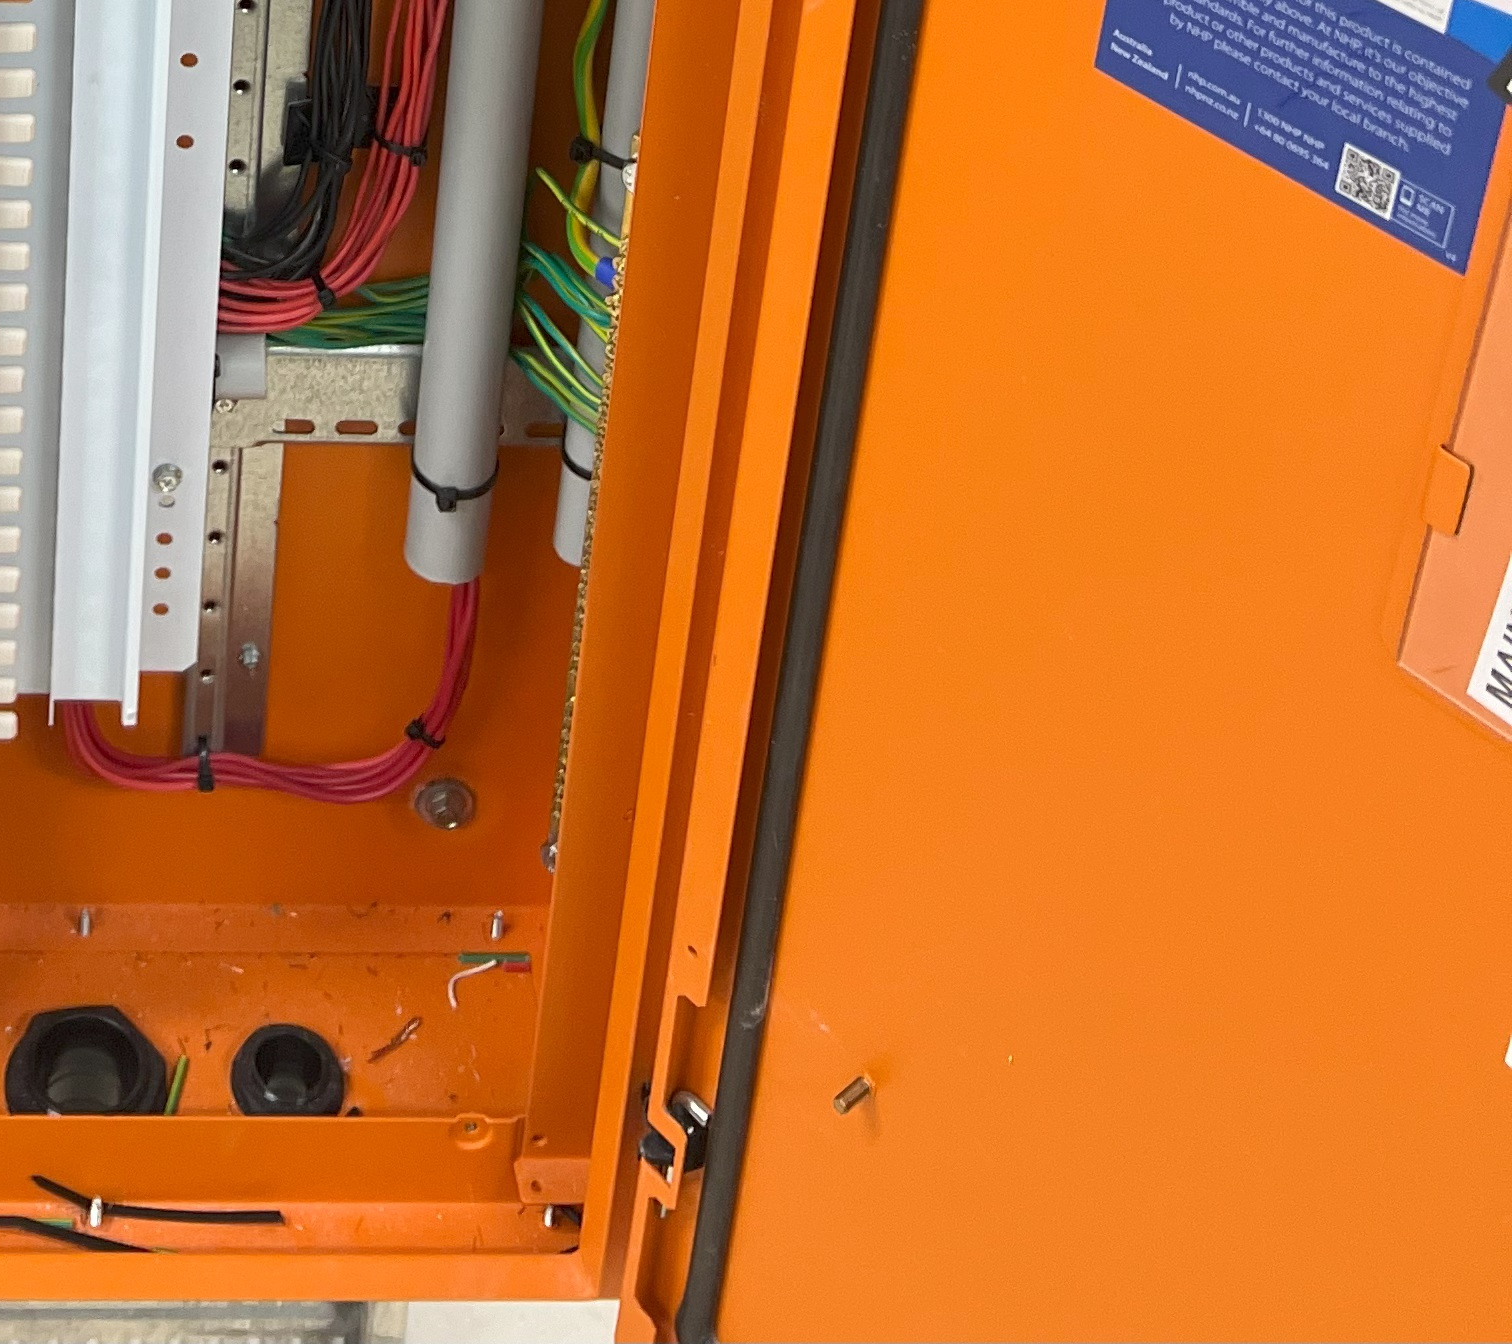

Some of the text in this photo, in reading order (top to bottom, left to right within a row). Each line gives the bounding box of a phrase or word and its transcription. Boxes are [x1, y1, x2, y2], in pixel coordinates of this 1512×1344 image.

[1169, 13, 1185, 31] by
[1186, 21, 1214, 42] NHP
[1213, 39, 1252, 66] please
[1253, 61, 1300, 92] contact
[1300, 86, 1330, 107] your
[1331, 99, 1362, 124] local
[1315, 1, 1337, 22] this
[1339, 15, 1391, 49] product
[1404, 50, 1473, 90] contained
